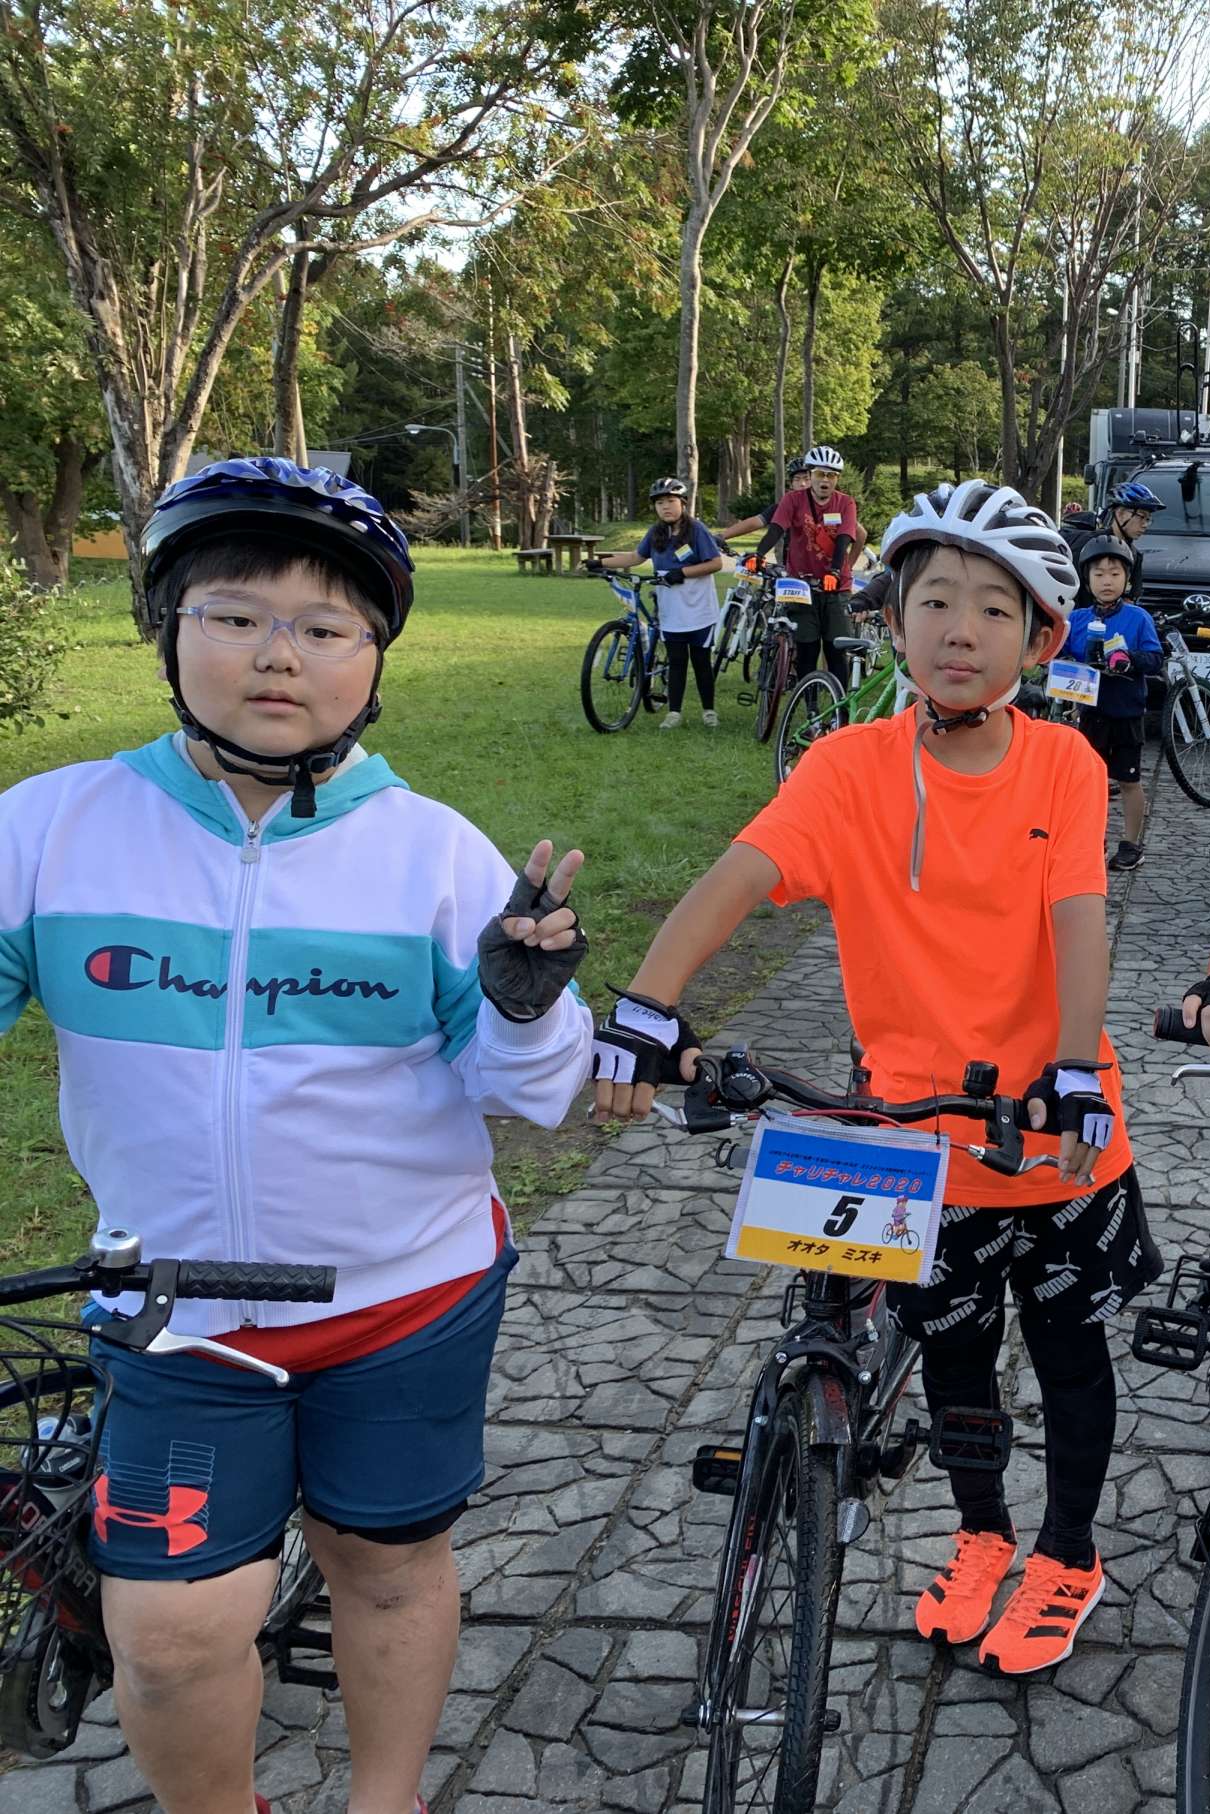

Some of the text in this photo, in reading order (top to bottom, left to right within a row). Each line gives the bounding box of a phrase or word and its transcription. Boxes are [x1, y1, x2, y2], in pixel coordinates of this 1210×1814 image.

[775, 1160, 923, 1194] チャリチャレ2020
[823, 1195, 865, 1237] 5
[786, 1239, 883, 1264] オオタ ミズキ
[1033, 1268, 1079, 1302] PUMA
[922, 1299, 978, 1336] PUMA
